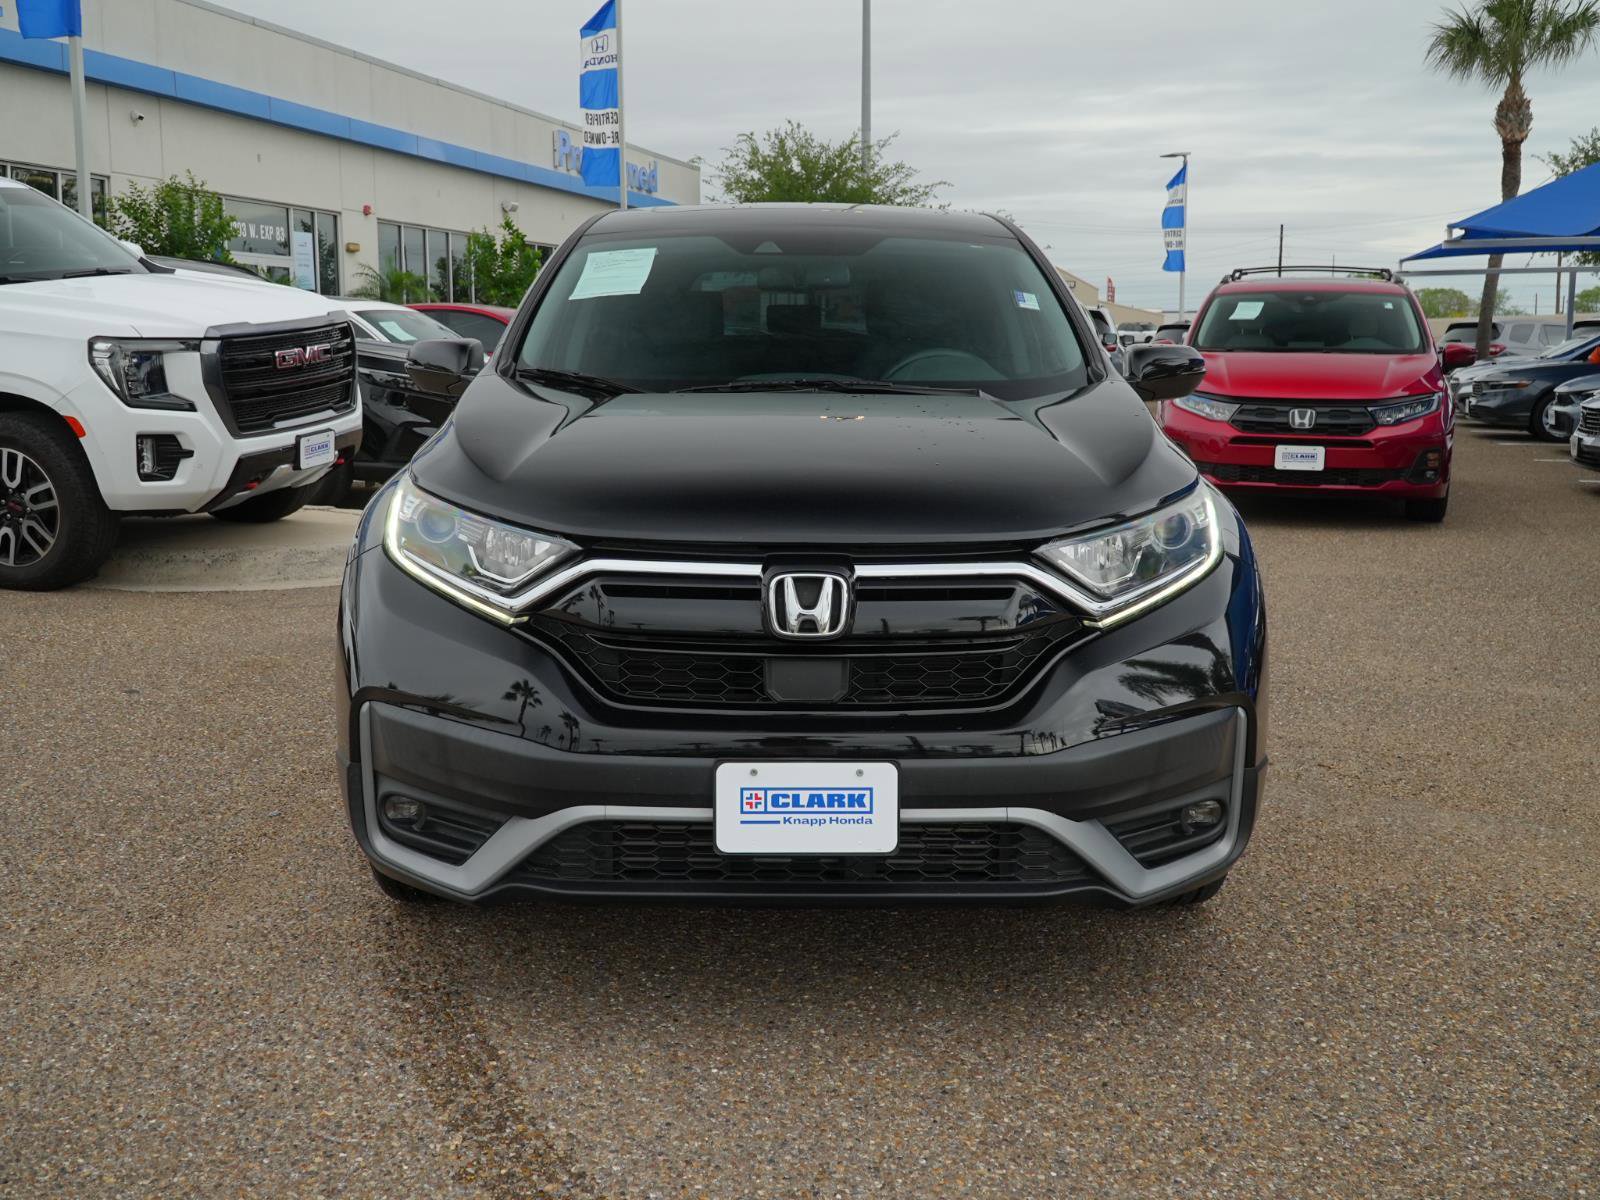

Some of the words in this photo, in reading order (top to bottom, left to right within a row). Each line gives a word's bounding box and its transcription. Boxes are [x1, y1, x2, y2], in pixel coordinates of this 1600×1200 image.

[249, 223, 259, 239] W.
[260, 224, 274, 241] EXP
[275, 226, 286, 242] 83
[275, 343, 332, 369] GMC
[770, 793, 867, 809] CLARK
[783, 816, 827, 827] Knapp
[829, 816, 873, 825] Honda
